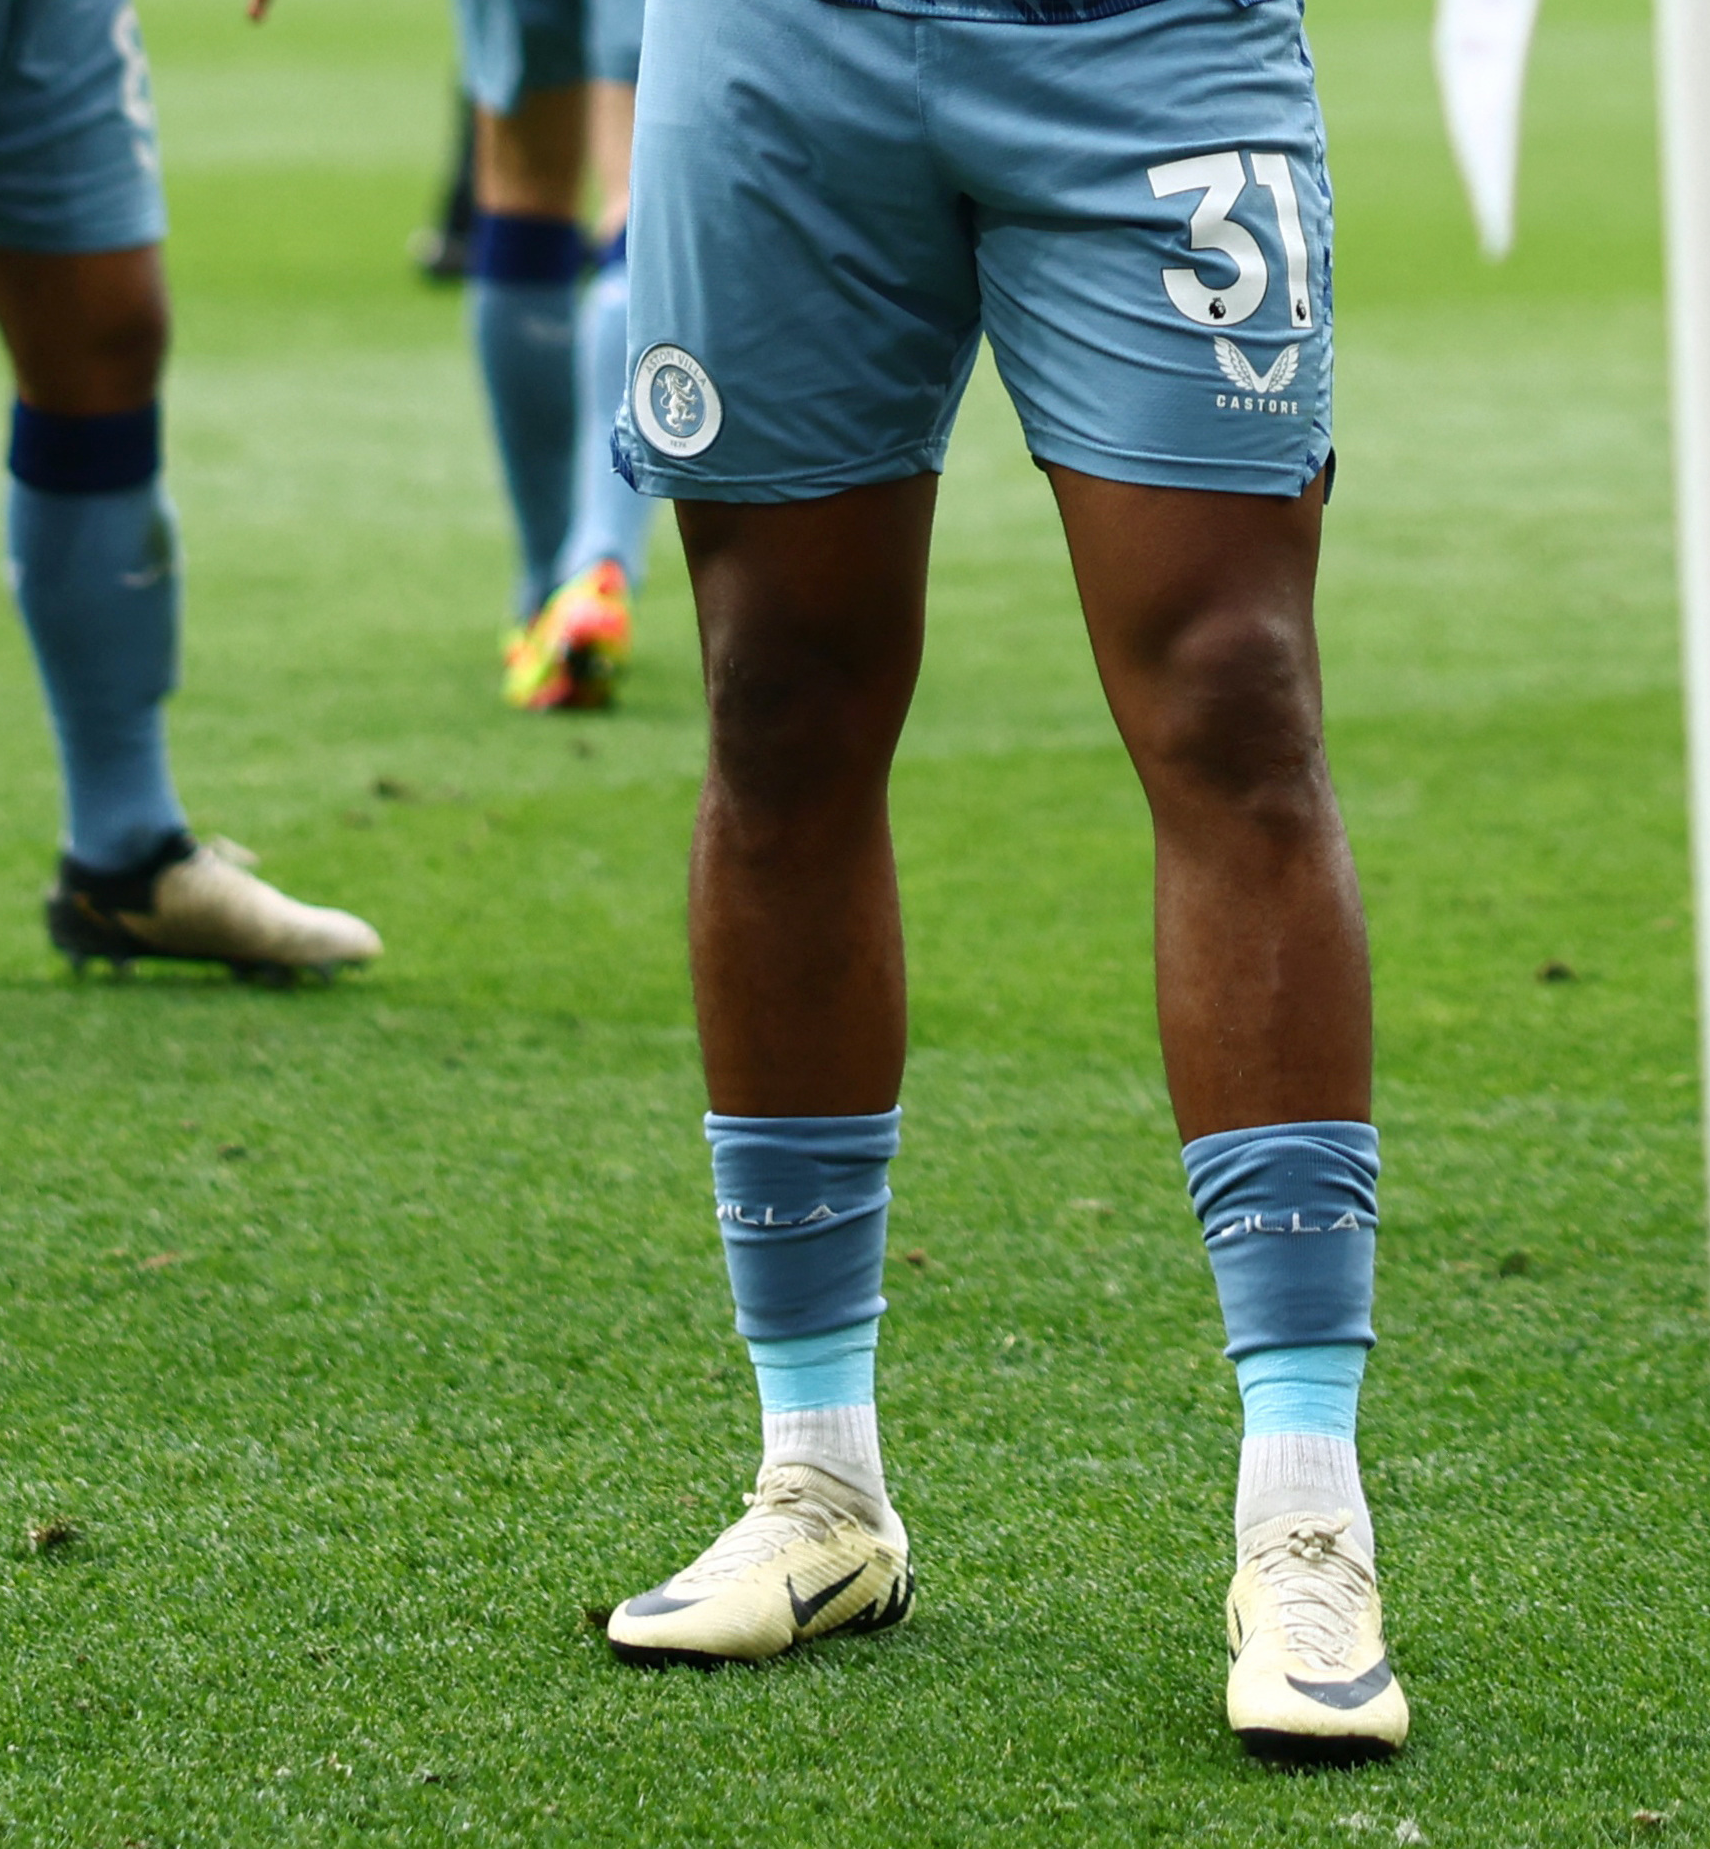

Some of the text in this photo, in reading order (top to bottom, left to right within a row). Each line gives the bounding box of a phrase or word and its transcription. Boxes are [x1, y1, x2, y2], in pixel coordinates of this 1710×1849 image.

[1147, 150, 1313, 328] 31
[645, 350, 707, 386] ASTON VILLA
[1216, 394, 1299, 415] CASTORE
